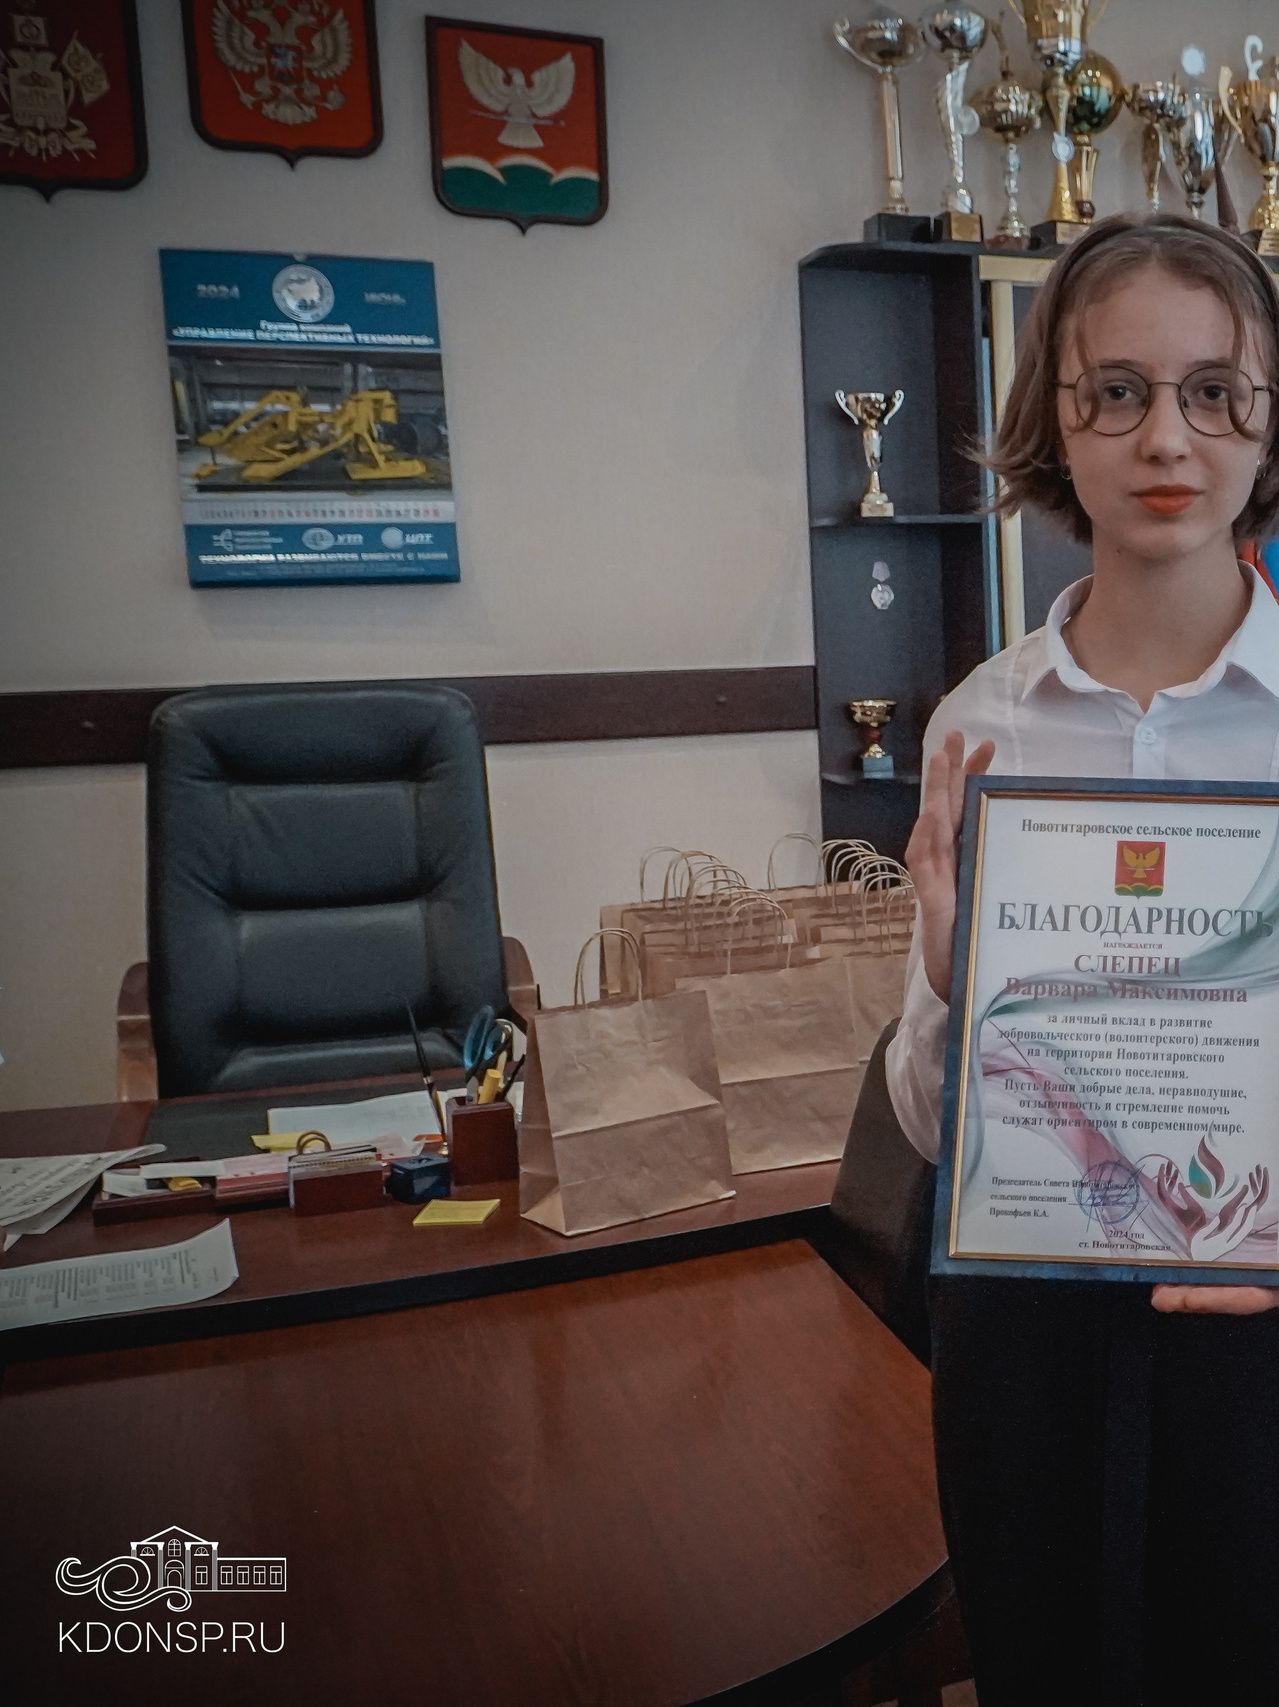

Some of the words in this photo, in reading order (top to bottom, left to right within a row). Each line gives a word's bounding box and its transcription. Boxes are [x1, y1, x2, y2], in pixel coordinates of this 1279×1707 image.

[1021, 818, 1133, 837] Новотитаровское
[1136, 824, 1192, 837] сельское
[1196, 826, 1262, 839] поселение
[997, 901, 1274, 940] БЛАГОДАРНОСТЬ
[1074, 954, 1181, 977] СЛЕПЕЦ
[1004, 977, 1098, 1001] Варвара
[1106, 978, 1248, 1003] Максимовна
[1048, 1015, 1058, 1024] за
[1061, 1013, 1107, 1025] личный
[1112, 1017, 1146, 1027] вклад
[1150, 1018, 1156, 1027] в
[1159, 1018, 1213, 1030] развитие
[1104, 1031, 1199, 1046] (волонтерского)
[1201, 1036, 1260, 1047] движения
[1027, 1048, 1040, 1057] на
[1045, 1048, 1112, 1061] территории
[1116, 1048, 1225, 1064] Новотитаровского
[1063, 1066, 1122, 1077] сельского
[1125, 1068, 1189, 1079] поселения.
[1004, 1078, 1039, 1094] Пусть
[1043, 1080, 1075, 1093] Ваши
[1079, 1081, 1122, 1098] добрые
[1125, 1086, 1155, 1097] дела,
[1105, 1102, 1112, 1111] и
[1115, 1102, 1184, 1115] стремление
[1187, 1105, 1230, 1116] помочь
[1002, 1115, 1043, 1128] служат
[1121, 1121, 1128, 1129] в
[1131, 1121, 1209, 1135] современном
[1109, 1230, 1128, 1239] 2024
